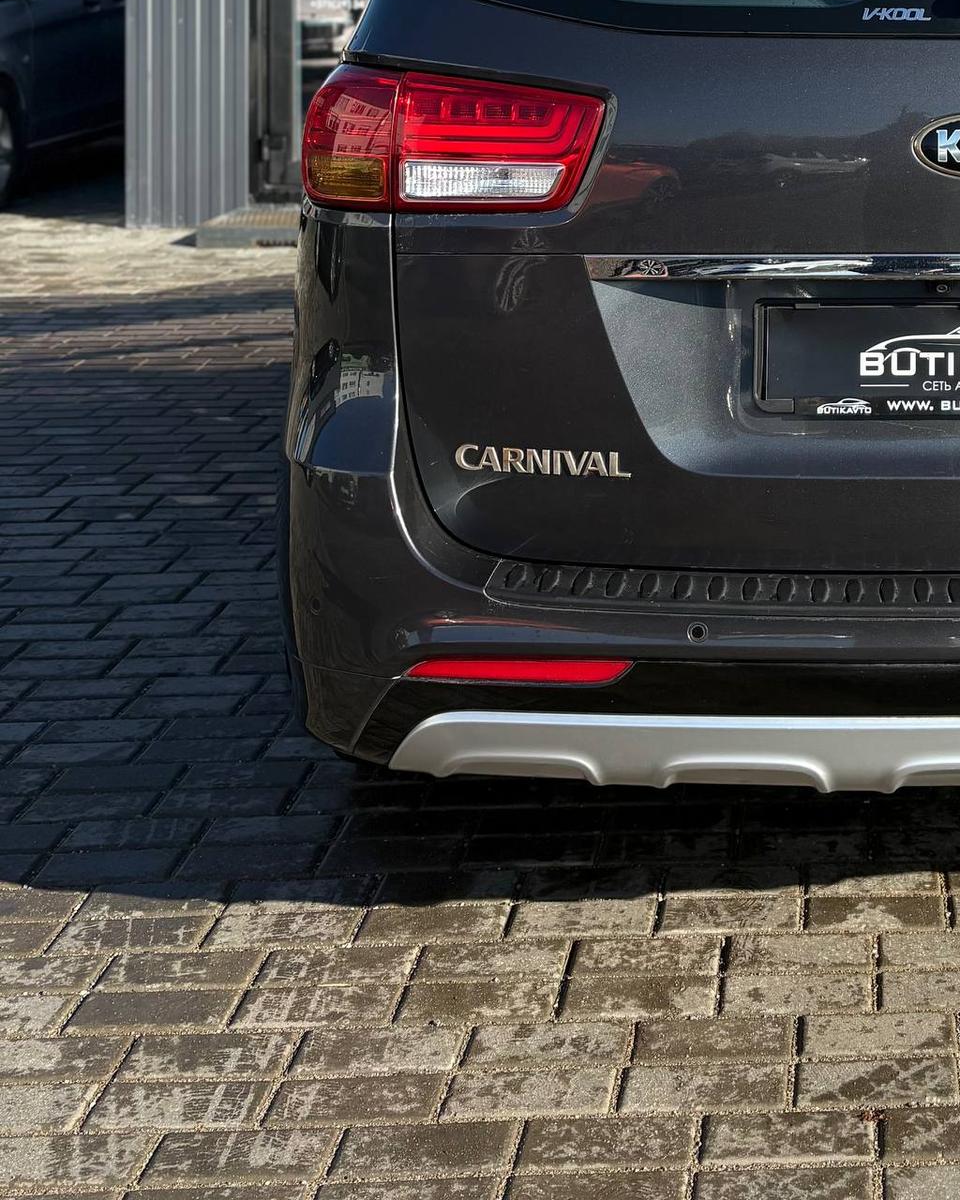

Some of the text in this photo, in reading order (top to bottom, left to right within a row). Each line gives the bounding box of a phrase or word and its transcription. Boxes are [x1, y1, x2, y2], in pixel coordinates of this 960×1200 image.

[862, 7, 932, 21] V-KOOL
[922, 380, 951, 392] СЕТЬ
[816, 405, 872, 414] BUTIKAVTO
[887, 400, 934, 411] WWW.
[455, 444, 632, 479] CARNIVAL
